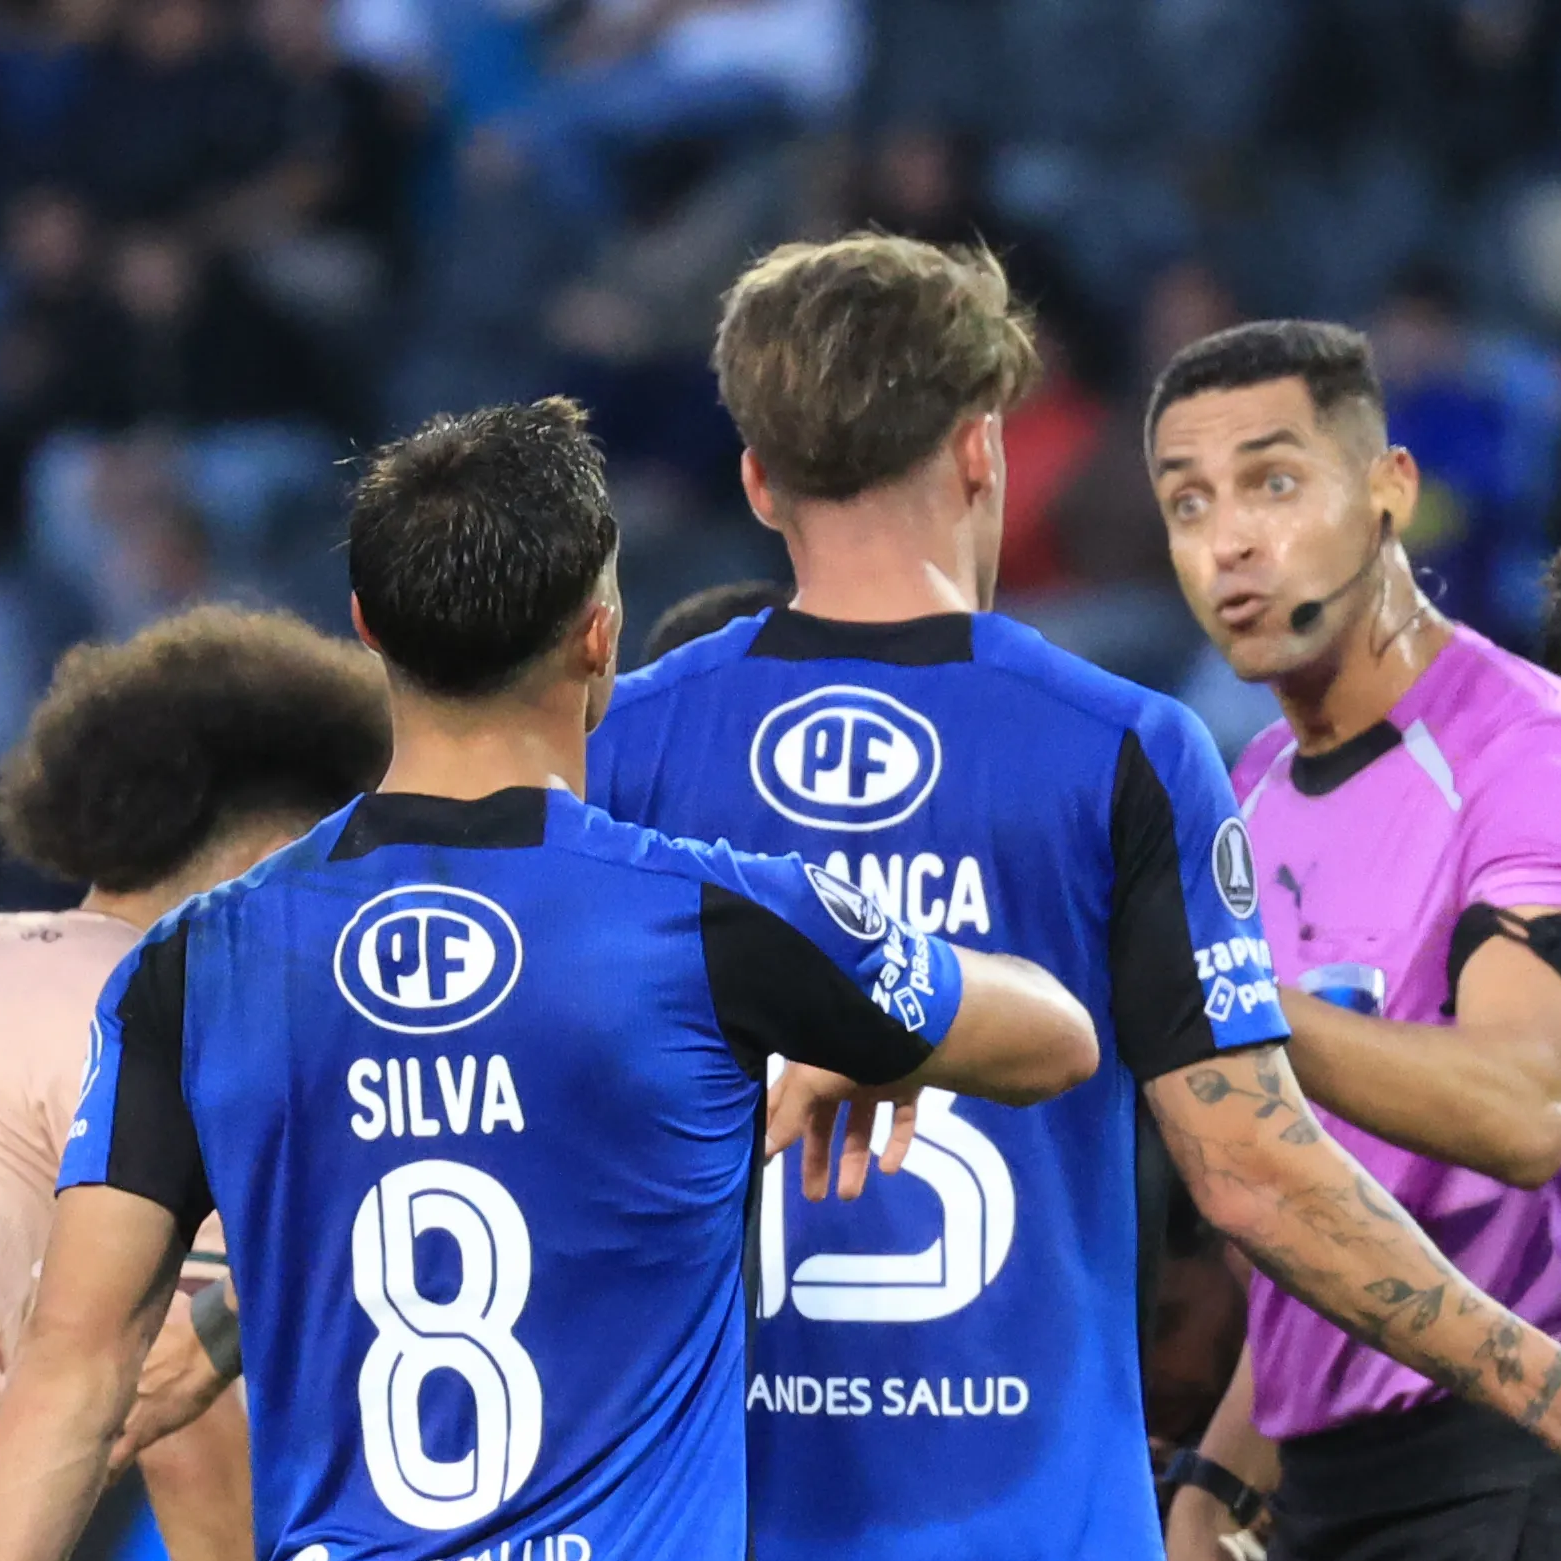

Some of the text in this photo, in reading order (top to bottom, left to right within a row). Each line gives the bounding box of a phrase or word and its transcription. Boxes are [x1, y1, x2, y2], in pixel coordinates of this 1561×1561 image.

[346, 1053, 526, 1142] SILVA
[351, 1159, 543, 1531] 8
[745, 1373, 1030, 1417] ANDES SALUD
